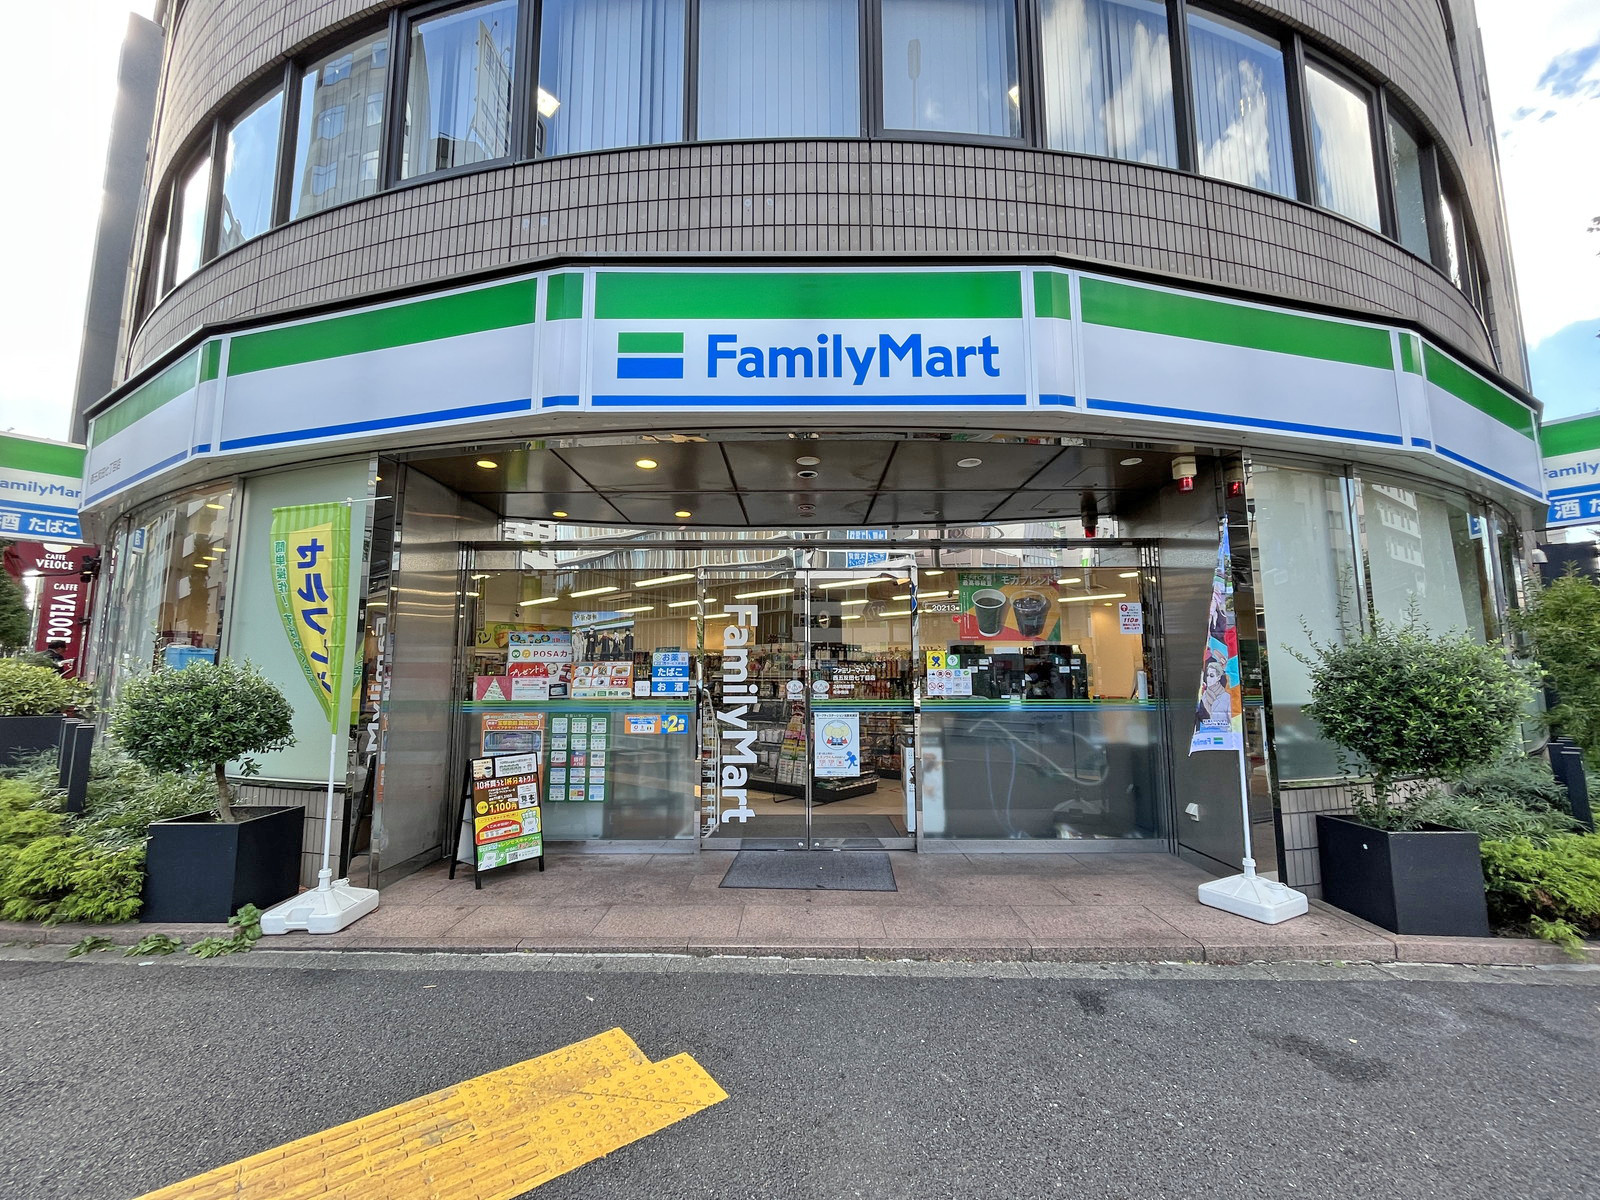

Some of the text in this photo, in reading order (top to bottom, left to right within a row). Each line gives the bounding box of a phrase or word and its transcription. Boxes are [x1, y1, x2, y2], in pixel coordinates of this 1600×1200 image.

[707, 333, 1000, 386] FamilyMart
[1554, 499, 1581, 519] 酒
[28, 517, 77, 535] たばこ
[36, 558, 74, 571] VELOCE
[45, 553, 67, 561] CAFFE
[53, 583, 79, 592] CAFFE
[45, 593, 78, 644] VELOCE
[662, 653, 679, 662] お薬
[657, 667, 683, 677] たばこ
[716, 604, 759, 824] FamilyMart
